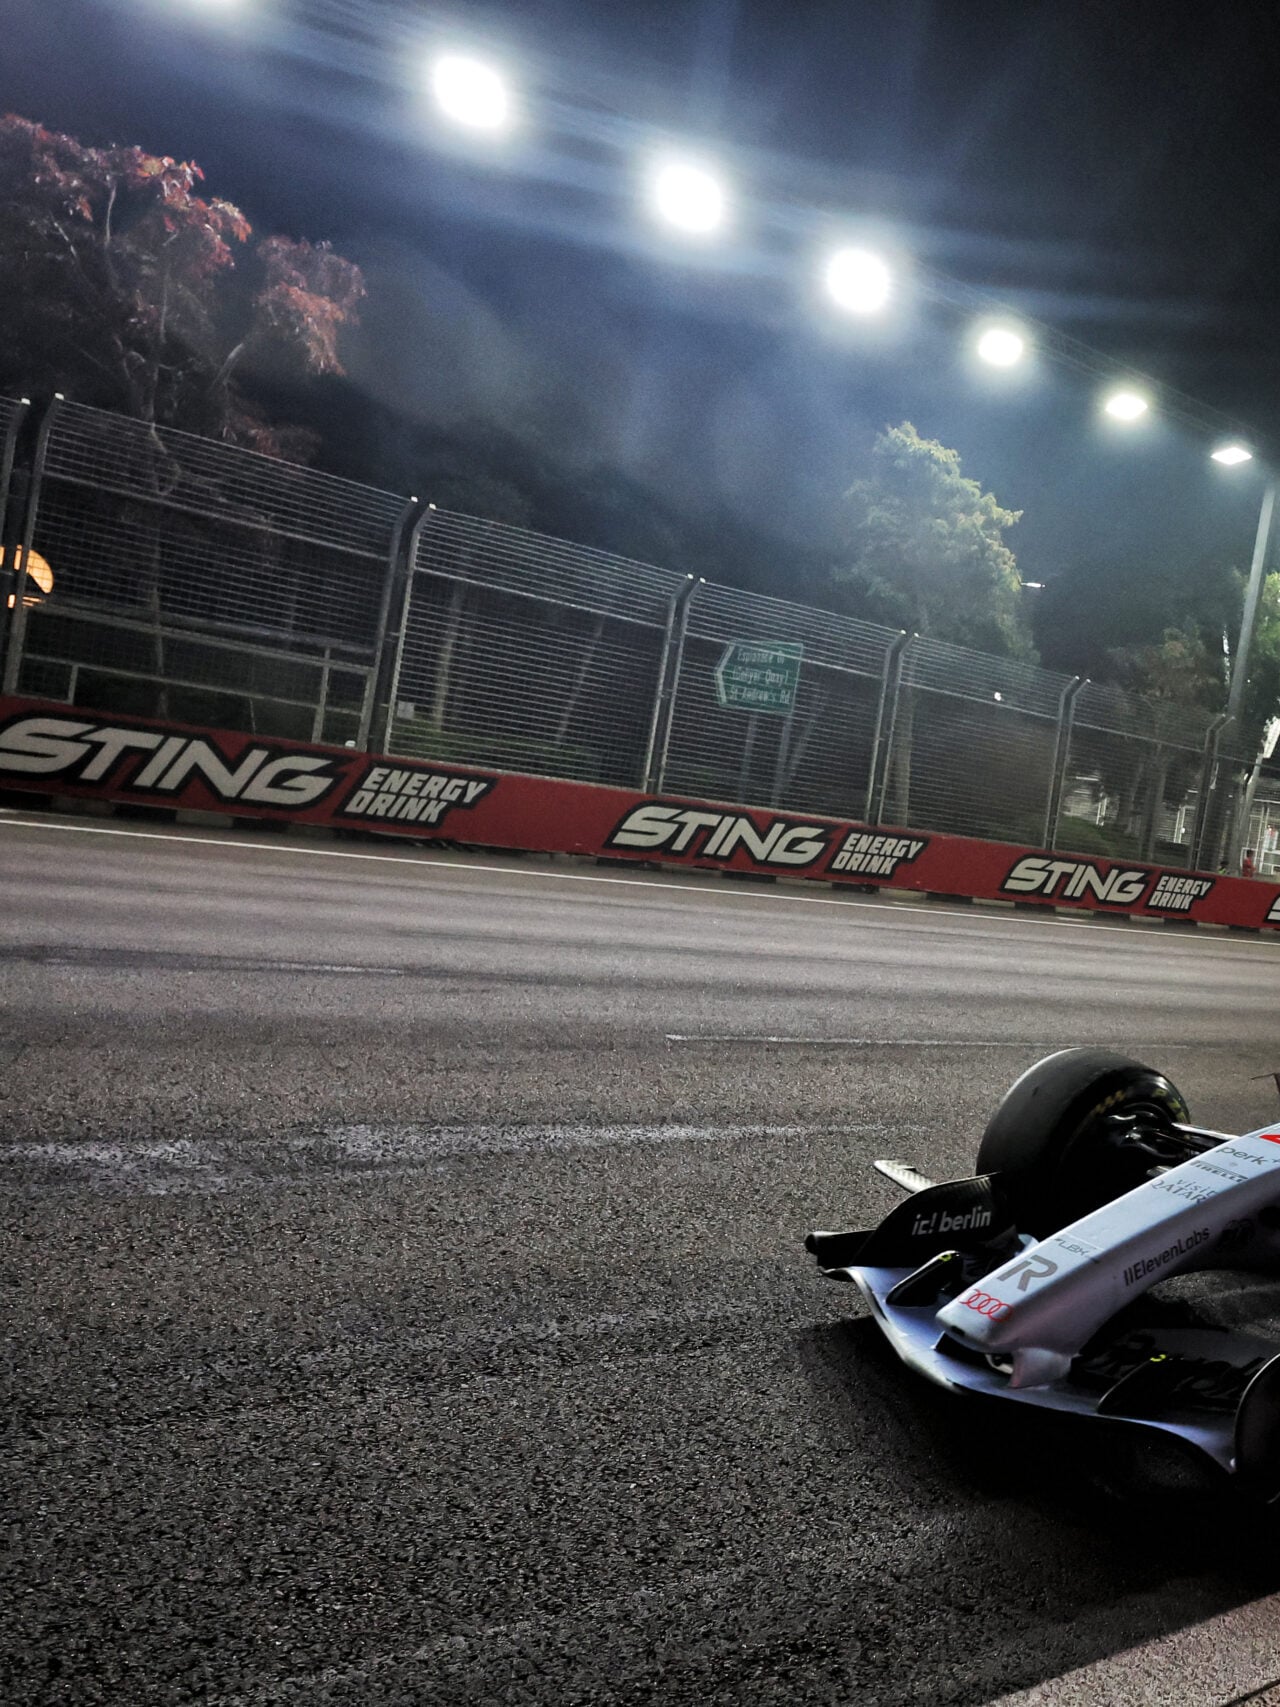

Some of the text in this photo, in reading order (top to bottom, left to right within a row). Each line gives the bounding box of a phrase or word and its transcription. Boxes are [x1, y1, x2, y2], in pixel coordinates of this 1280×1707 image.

[0, 718, 335, 805] STING
[362, 767, 488, 803] ENERGY
[344, 790, 447, 824] DRINK
[612, 806, 826, 864] STING
[842, 832, 924, 859] ENERGY
[832, 852, 899, 875] DRINK
[1004, 858, 1149, 902] STING
[1155, 875, 1212, 897] ENERGY
[1148, 890, 1193, 911] DRINK
[938, 1205, 992, 1232] berlin
